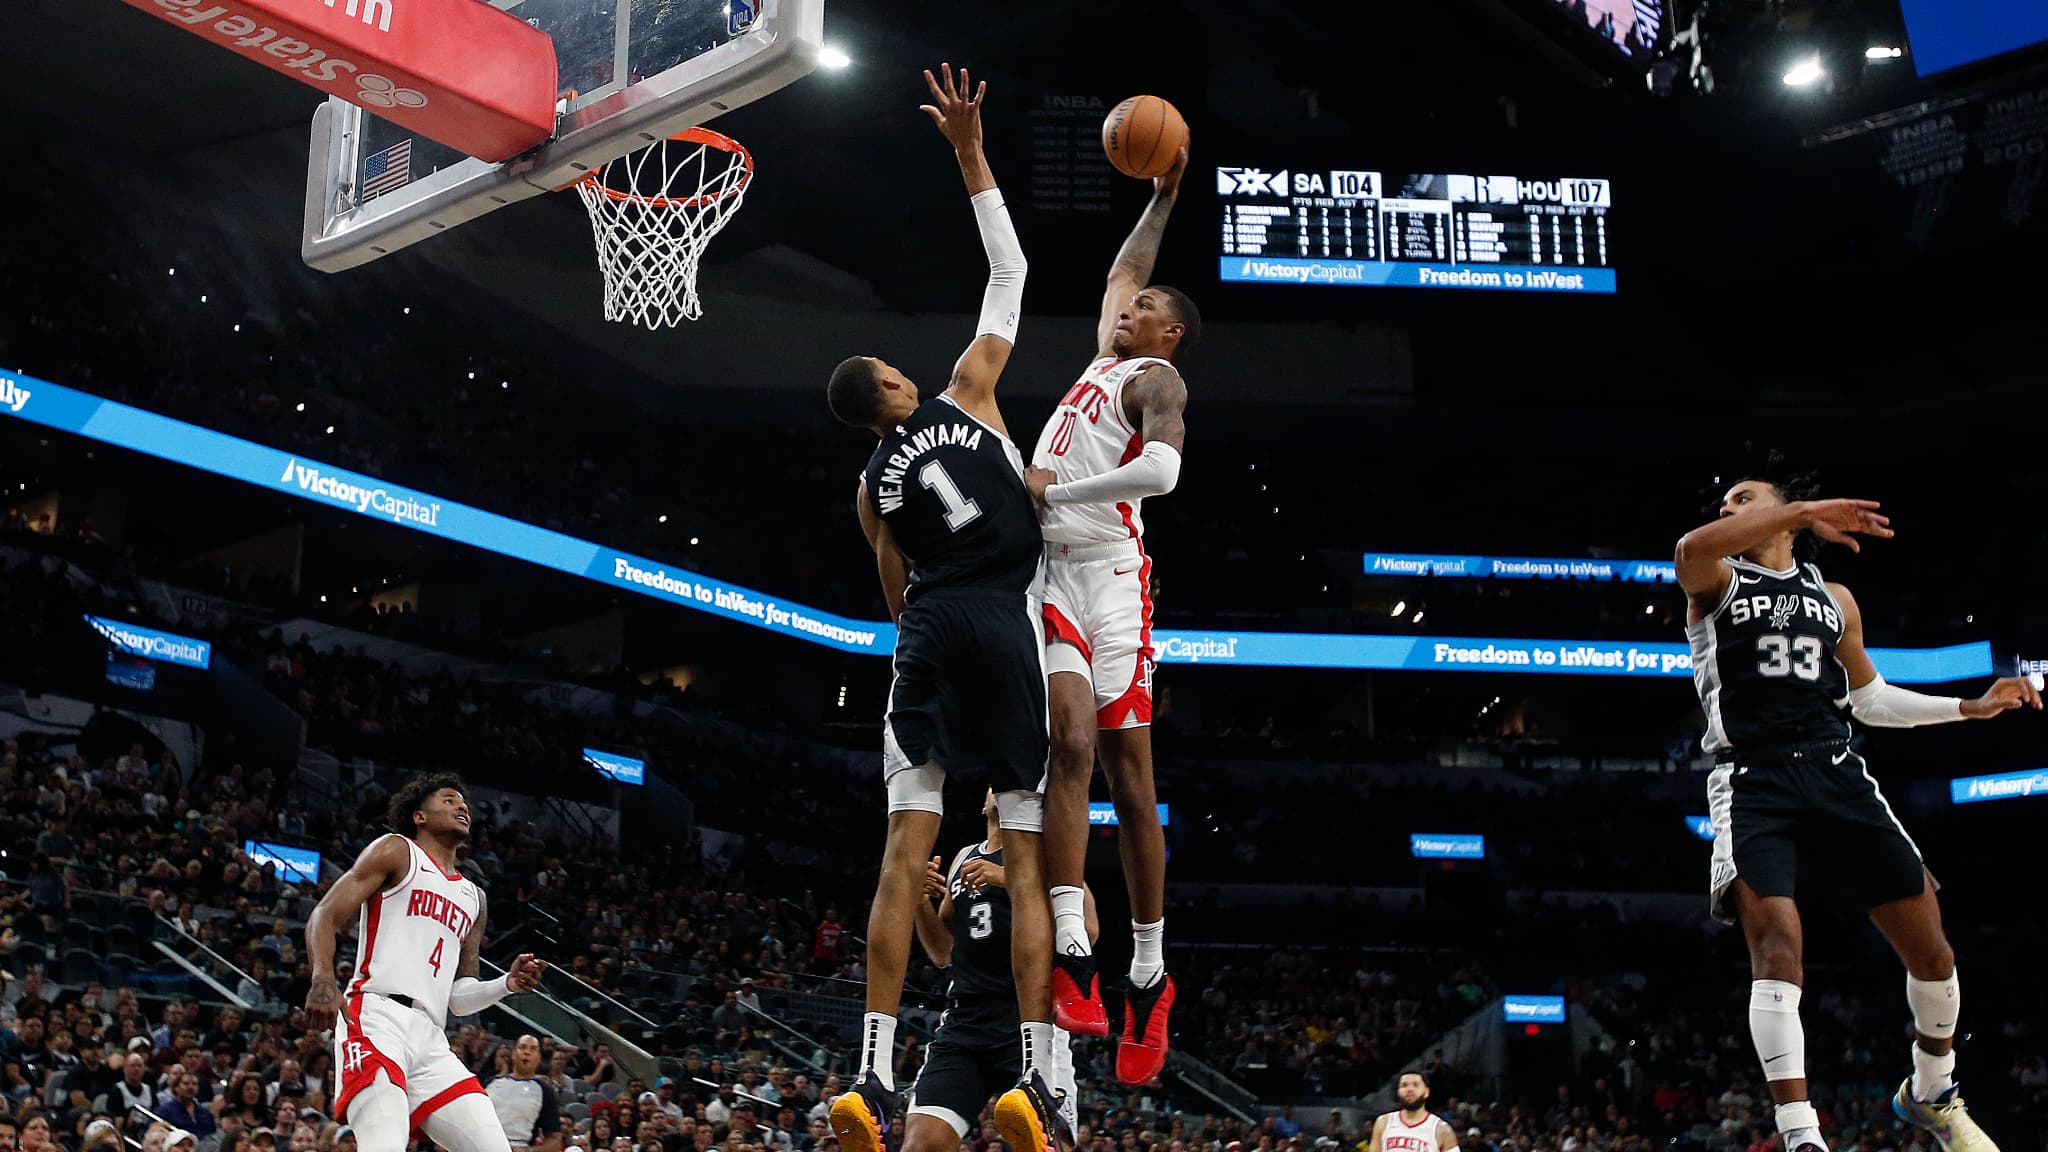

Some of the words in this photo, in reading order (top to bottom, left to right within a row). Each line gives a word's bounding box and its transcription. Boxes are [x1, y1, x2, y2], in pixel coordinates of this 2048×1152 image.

[1293, 173, 1325, 194] SA
[1337, 175, 1373, 195] 104
[1517, 180, 1561, 201] HOU
[1569, 182, 1603, 202] 107
[1251, 262, 1364, 282] VictoryCapital
[1418, 267, 1501, 287] Freedom
[1504, 272, 1523, 287] to
[1526, 271, 1584, 290] inVest
[1047, 411, 1077, 457] 10
[878, 423, 983, 515] WEMBANYAMA
[295, 465, 438, 527] VictoryCapital
[918, 458, 983, 533] 1
[1493, 560, 1552, 574] Freedom
[1554, 562, 1569, 575] to
[1570, 562, 1612, 577] inVest
[614, 558, 692, 598] Freedom
[694, 582, 713, 603] to
[715, 587, 765, 619] inVest
[764, 603, 790, 625] for
[791, 611, 875, 646] tomorrow
[1730, 594, 1839, 633] SPURS
[1434, 643, 1530, 665] Freedom
[1533, 648, 1556, 666] to
[1560, 646, 1625, 668] inVest
[1626, 648, 1658, 672] for
[1757, 633, 1823, 683] 33
[969, 902, 992, 939] 3
[429, 937, 444, 978] 4
